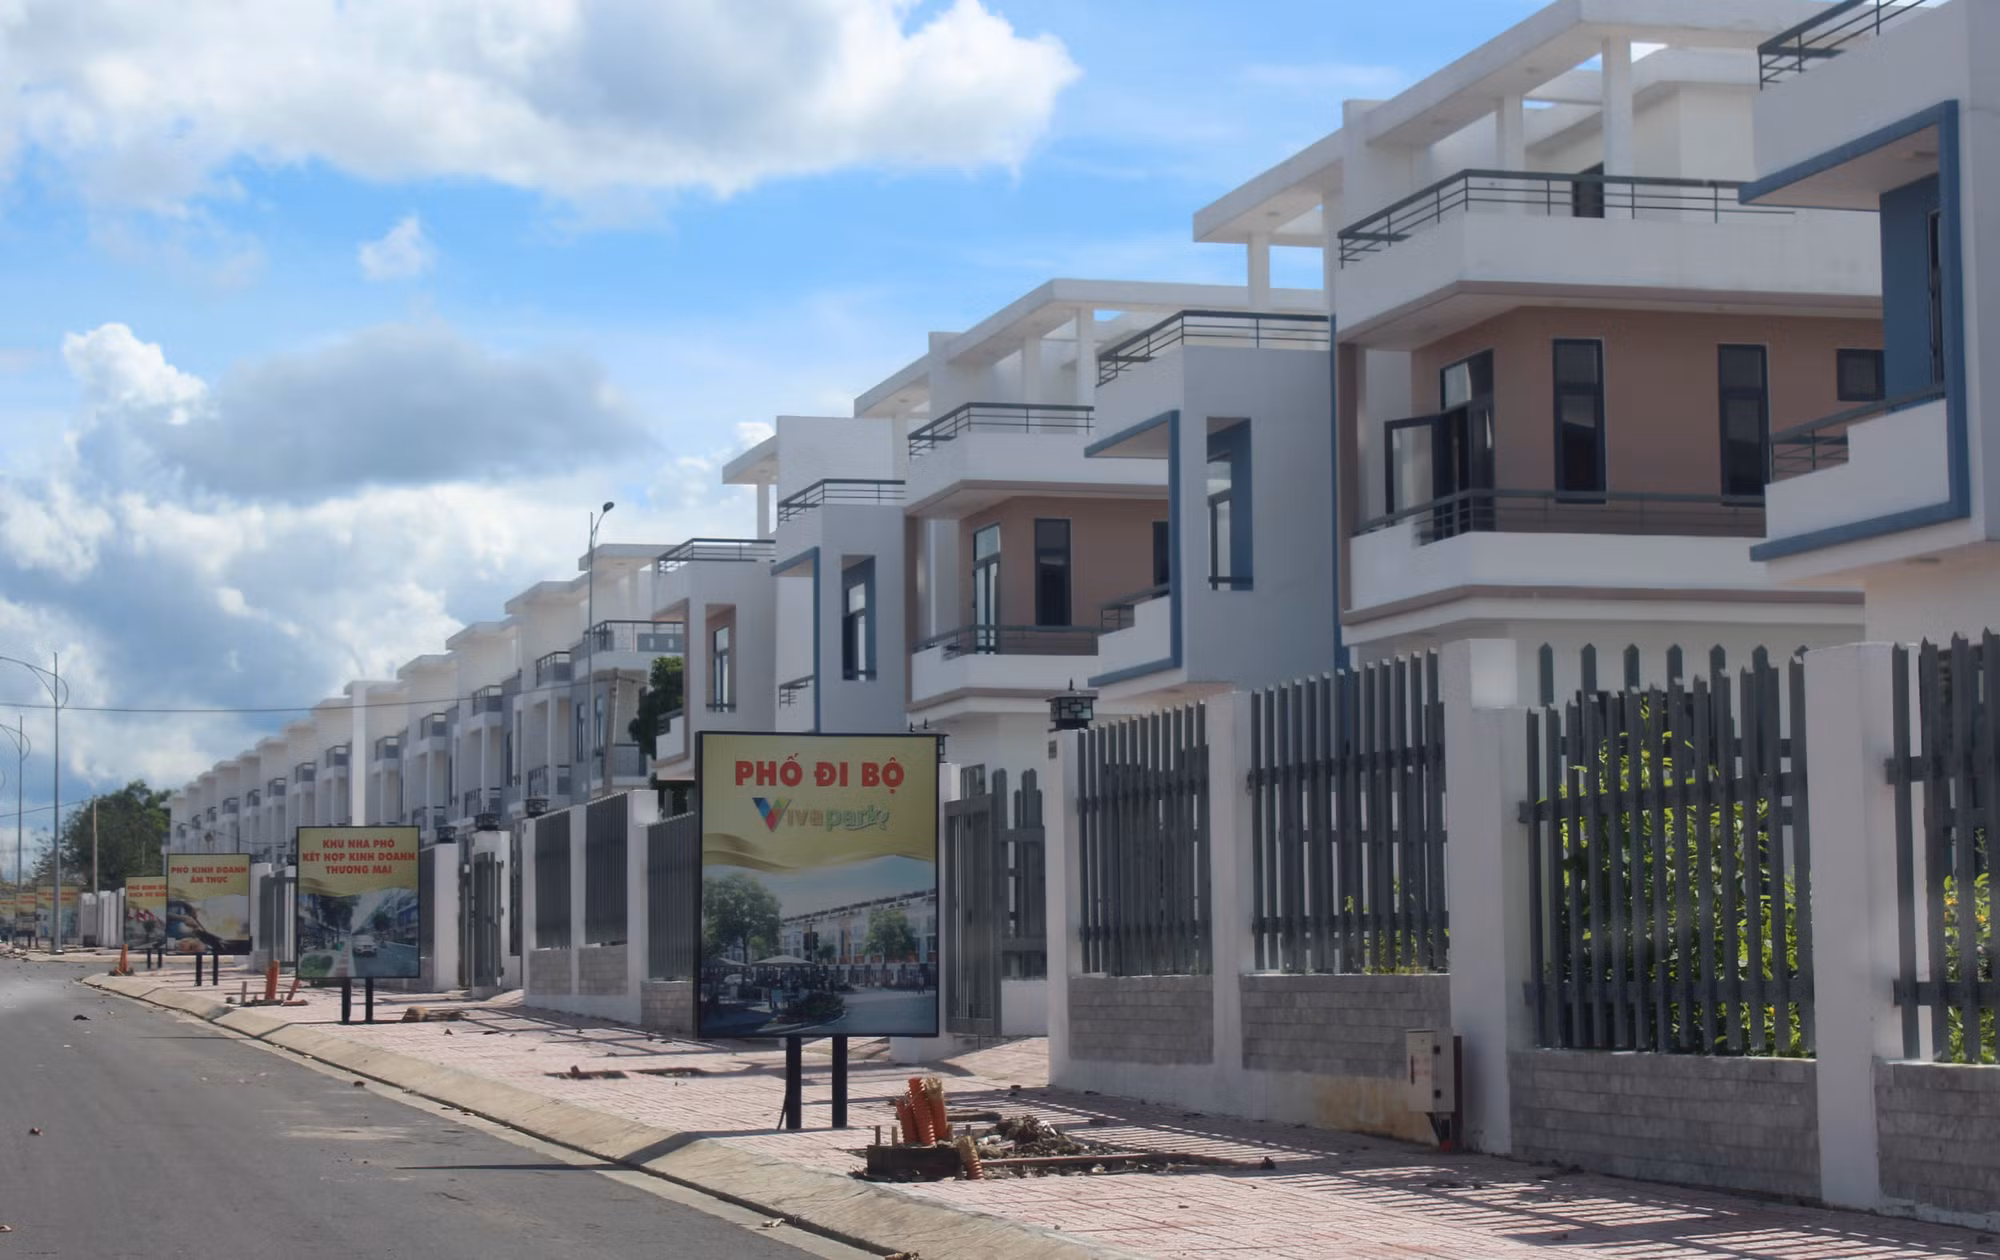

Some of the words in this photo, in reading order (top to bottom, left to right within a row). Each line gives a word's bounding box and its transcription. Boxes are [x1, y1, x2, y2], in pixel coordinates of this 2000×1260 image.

[735, 753, 803, 787] PHỐ
[814, 761, 849, 787] ĐI
[861, 757, 905, 795] BỘ
[323, 839, 344, 849] KHU
[349, 852, 374, 861] KINH
[378, 851, 416, 861] DOANH
